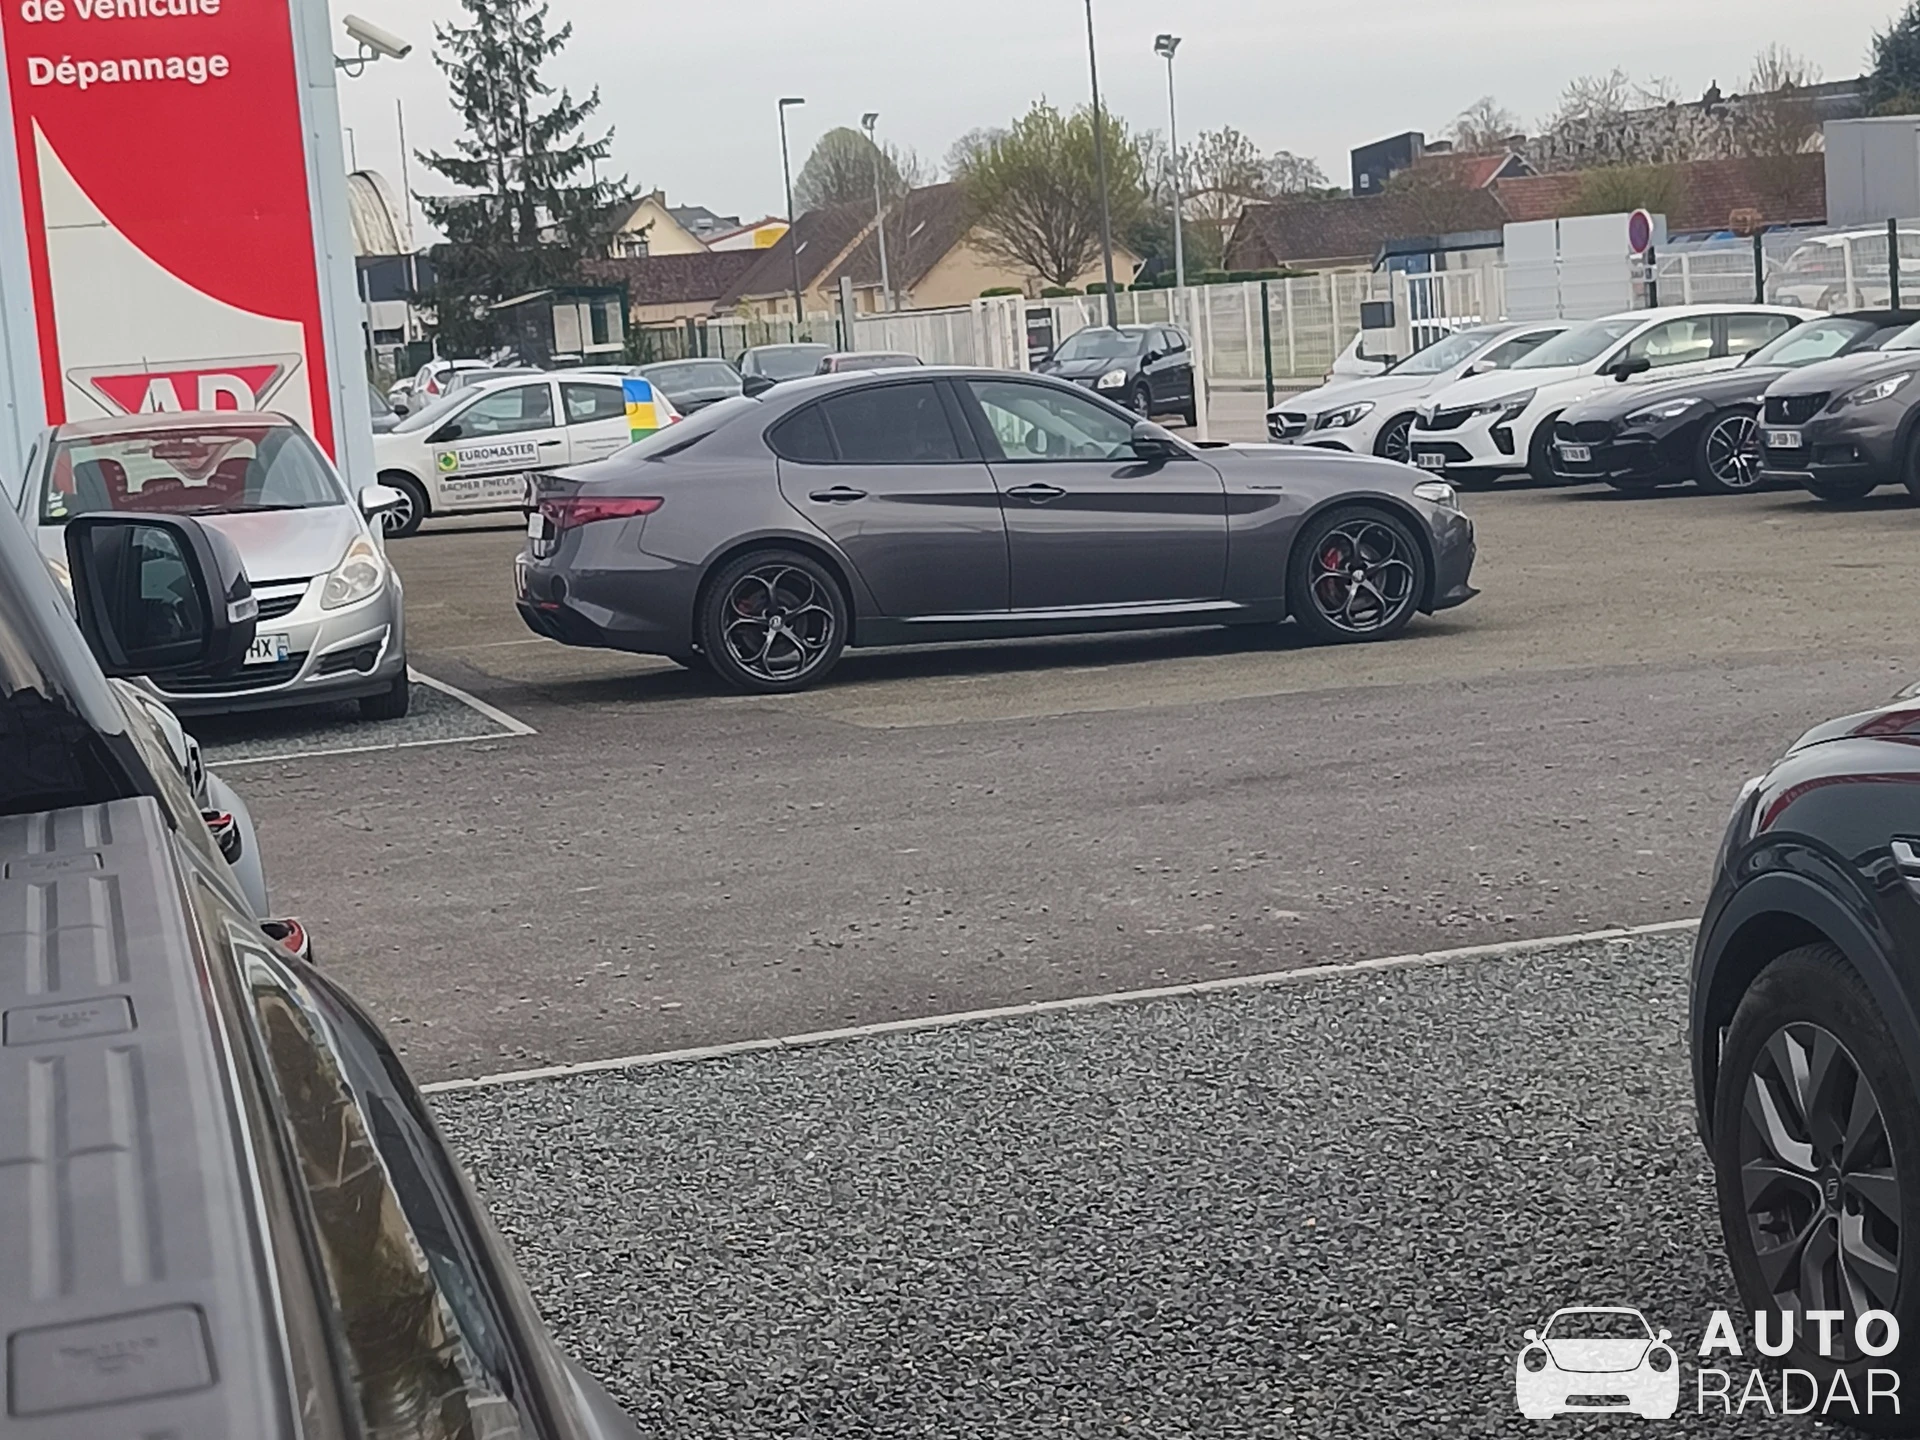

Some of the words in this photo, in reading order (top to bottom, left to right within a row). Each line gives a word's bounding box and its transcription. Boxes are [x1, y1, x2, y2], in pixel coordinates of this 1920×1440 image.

[21, 0, 65, 22] de
[27, 54, 230, 90] Dépannage
[459, 443, 534, 461] EUROMASTER
